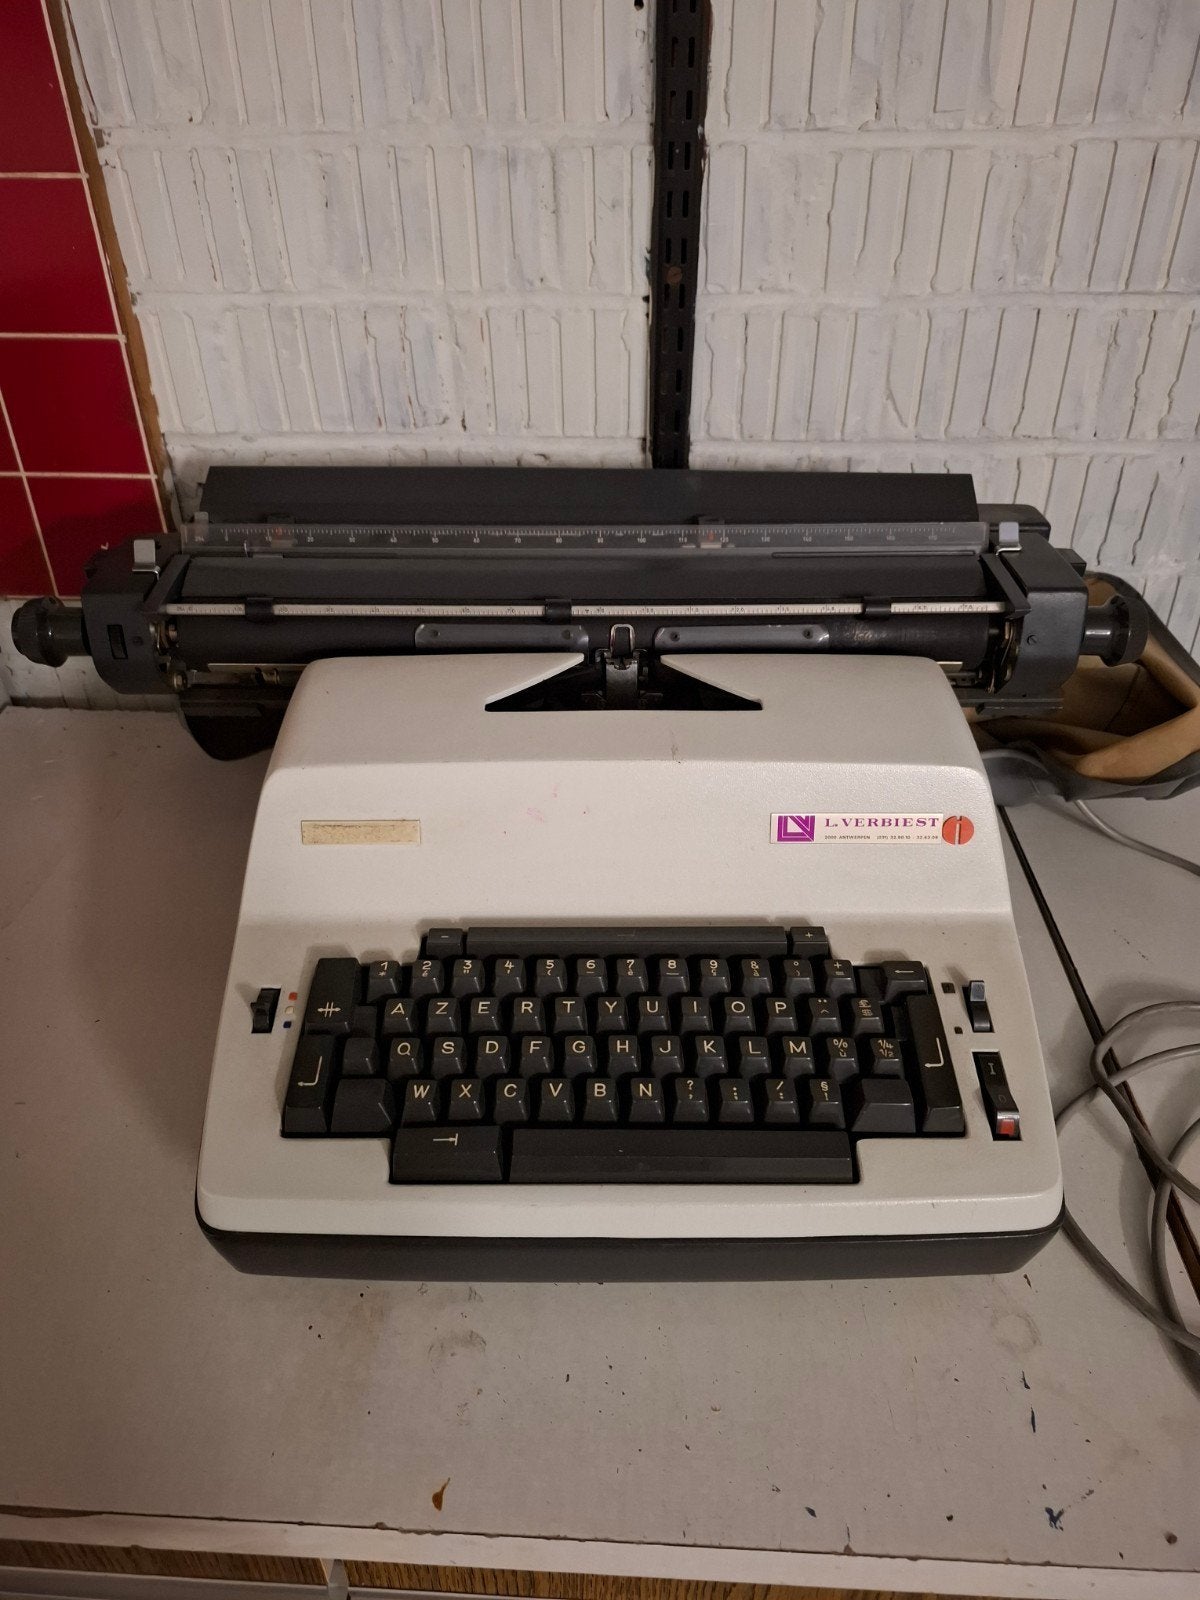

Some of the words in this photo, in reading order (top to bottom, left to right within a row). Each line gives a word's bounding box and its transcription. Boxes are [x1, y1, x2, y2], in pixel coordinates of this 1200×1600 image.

[380, 961, 389, 970] 1
[422, 960, 432, 970] 2
[463, 960, 472, 969] 3
[505, 960, 515, 970] 4
[546, 960, 555, 969] 5
[586, 960, 596, 969] 6
[627, 960, 635, 969] 7
[667, 960, 677, 969] 8
[710, 960, 718, 969] 9
[390, 1002, 405, 1015] A
[435, 1002, 449, 1015] Z
[477, 1001, 491, 1014] E
[521, 1001, 534, 1014] R
[562, 1001, 576, 1013] T
[605, 1001, 617, 1013] Y
[646, 1001, 659, 1013] U
[693, 1001, 698, 1013] I
[731, 1001, 746, 1013] O
[774, 1001, 787, 1014] P
[397, 1042, 411, 1056] Q
[441, 1041, 455, 1054] S
[485, 1041, 499, 1054] D
[529, 1041, 543, 1054] F
[572, 1040, 586, 1053] G
[616, 1040, 629, 1053] H
[659, 1040, 671, 1053] J
[703, 1040, 717, 1053] K
[748, 1040, 762, 1054] L
[789, 1040, 807, 1054] M
[413, 1084, 431, 1099] W
[459, 1084, 472, 1098] X
[503, 1083, 518, 1097] C
[549, 1083, 563, 1097] V
[594, 1083, 607, 1097] B
[639, 1083, 653, 1097] N
